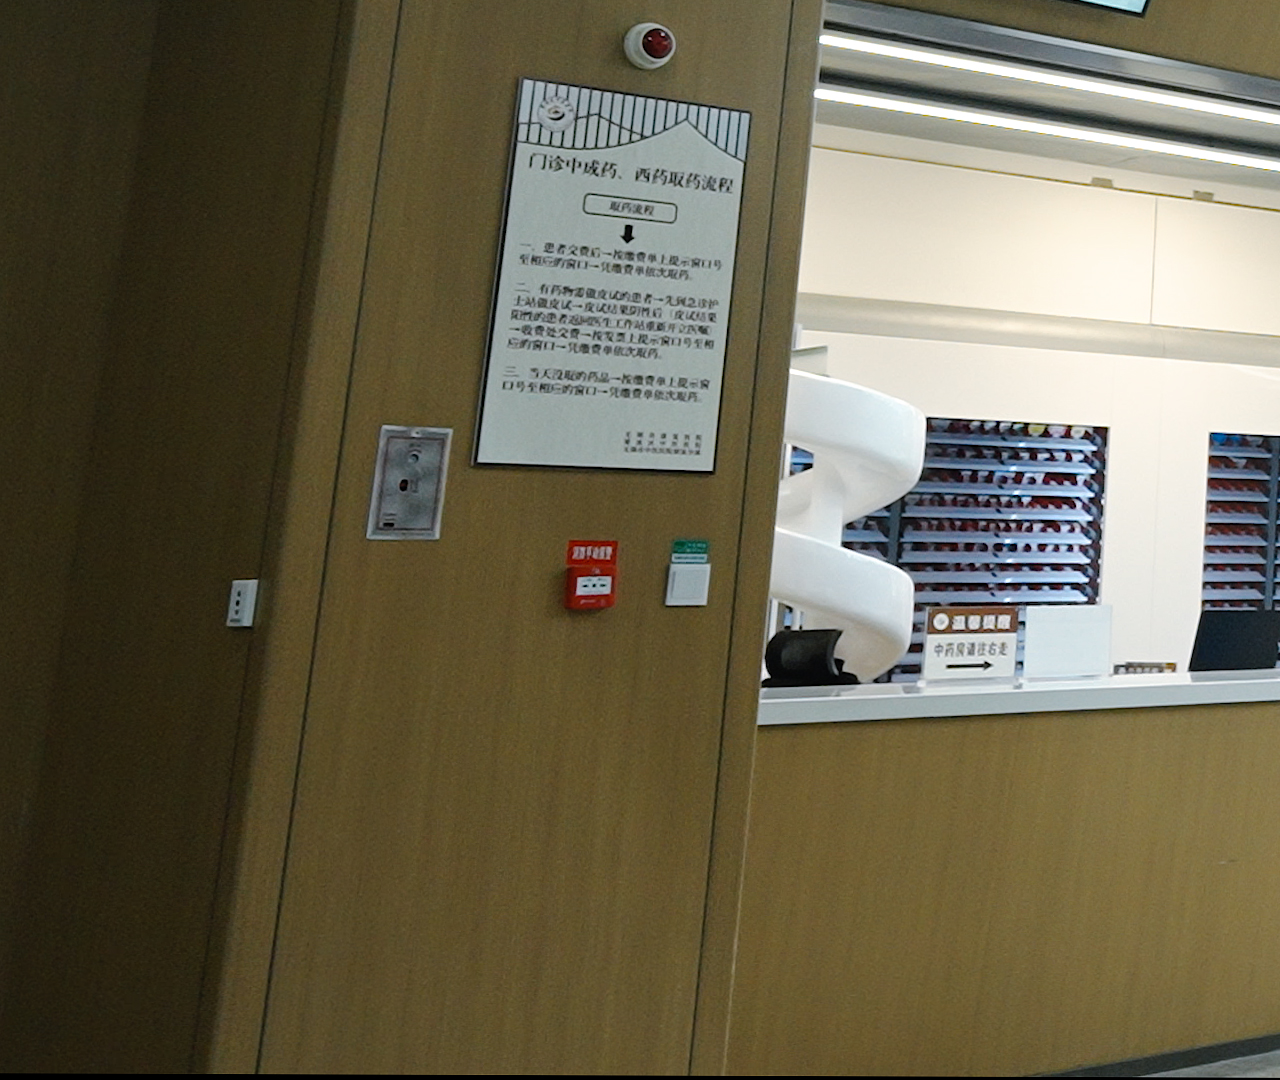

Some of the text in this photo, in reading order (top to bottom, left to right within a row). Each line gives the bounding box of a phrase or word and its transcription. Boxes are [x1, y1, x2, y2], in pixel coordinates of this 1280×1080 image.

[529, 152, 733, 194] 门诊中成药、西药取药流程
[609, 201, 655, 217] 取药流程
